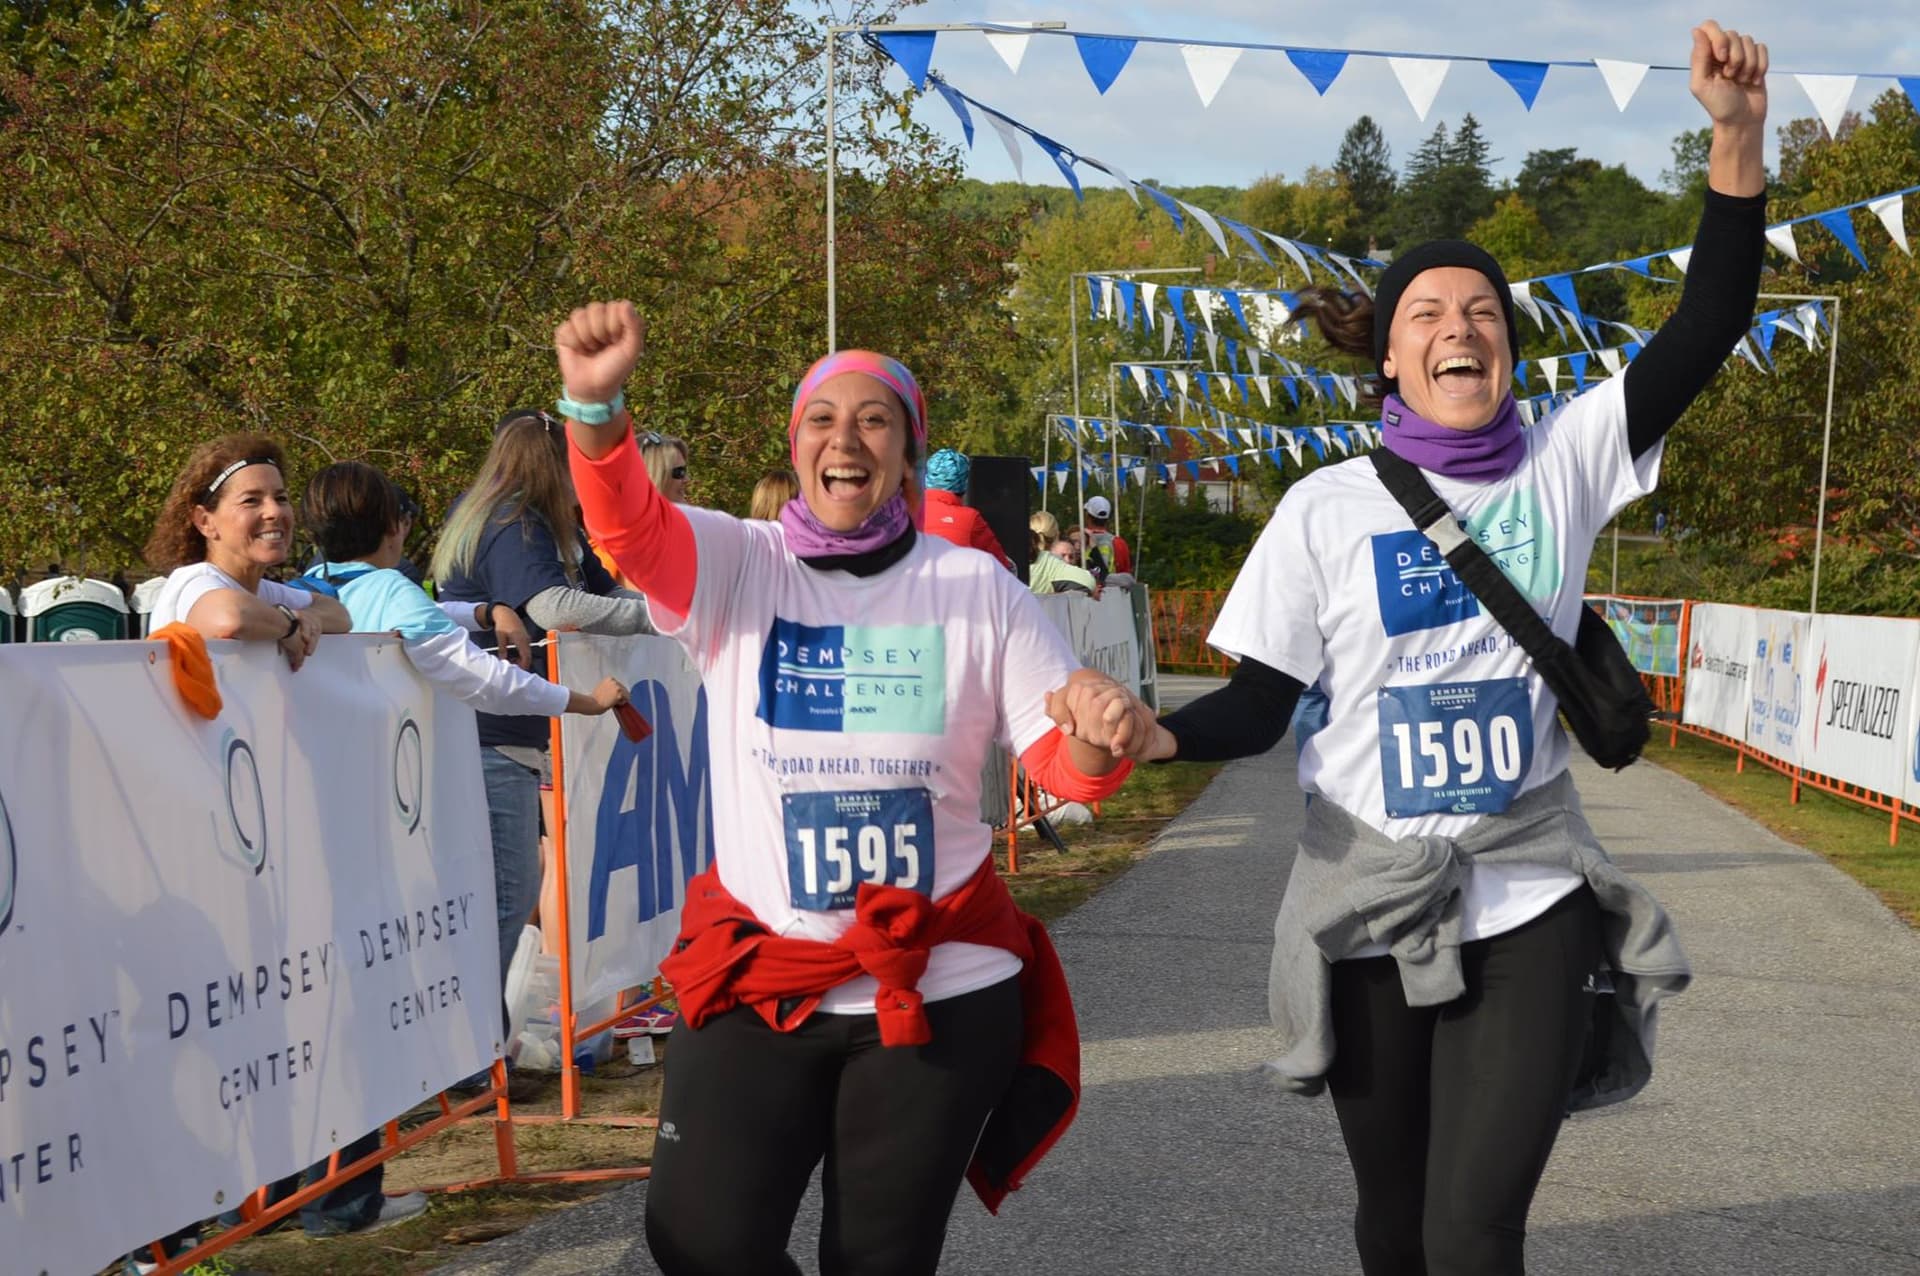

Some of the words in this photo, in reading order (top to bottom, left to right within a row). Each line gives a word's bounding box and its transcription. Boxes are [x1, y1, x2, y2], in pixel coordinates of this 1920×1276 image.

[777, 640, 922, 665] DEMPSEY
[1398, 656, 1421, 673] THE
[774, 680, 923, 698] CHALLENGE
[1826, 679, 1900, 740] SPECIALIZED
[782, 757, 814, 776] ROAD
[870, 757, 932, 777] TOGETHER
[1392, 715, 1521, 789] 1590
[797, 823, 920, 894] 1595
[360, 893, 470, 969] DEMPSEY
[168, 942, 329, 1040] DEMPSEY
[389, 975, 462, 1031] CENTER
[219, 1040, 313, 1110] CENTER
